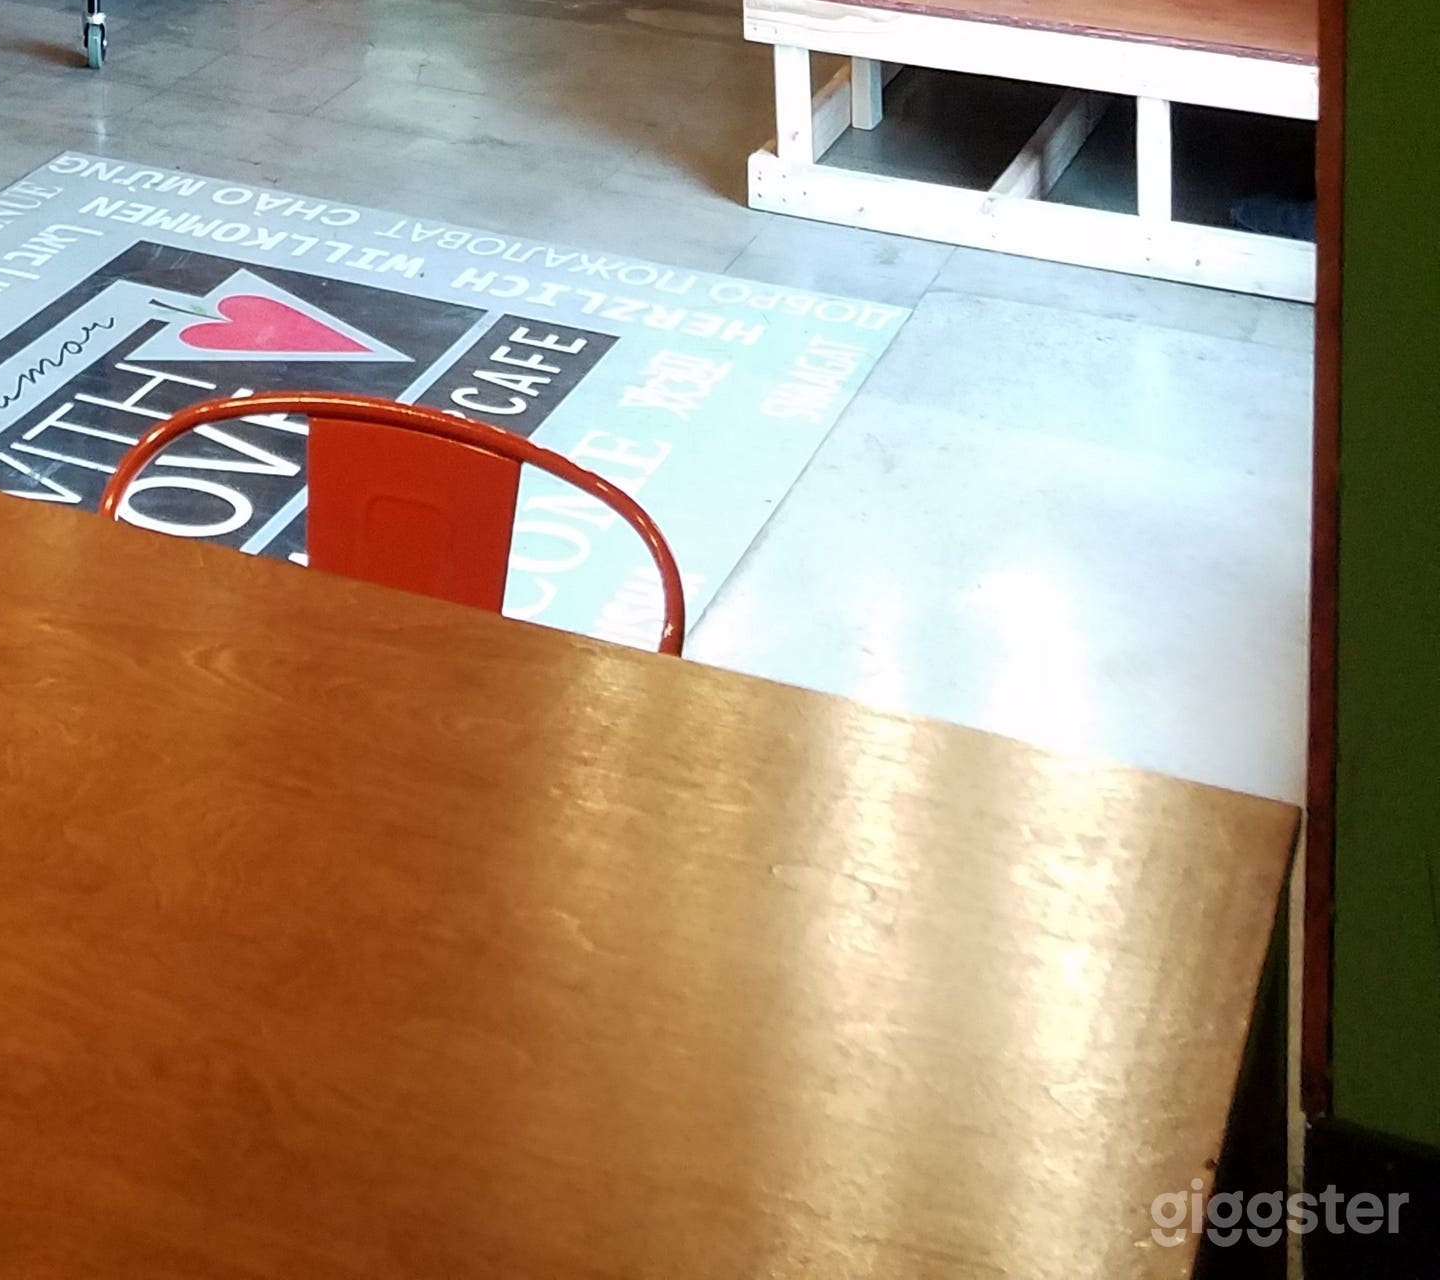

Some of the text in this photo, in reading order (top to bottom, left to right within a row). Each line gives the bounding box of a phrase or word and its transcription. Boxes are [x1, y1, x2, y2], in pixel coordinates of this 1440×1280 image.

[79, 195, 769, 347] HERZLICH WILLKOMMEN
[373, 218, 903, 332] ДОБРО ПОЖАЛОВАТ
[449, 325, 588, 415] CAFE
